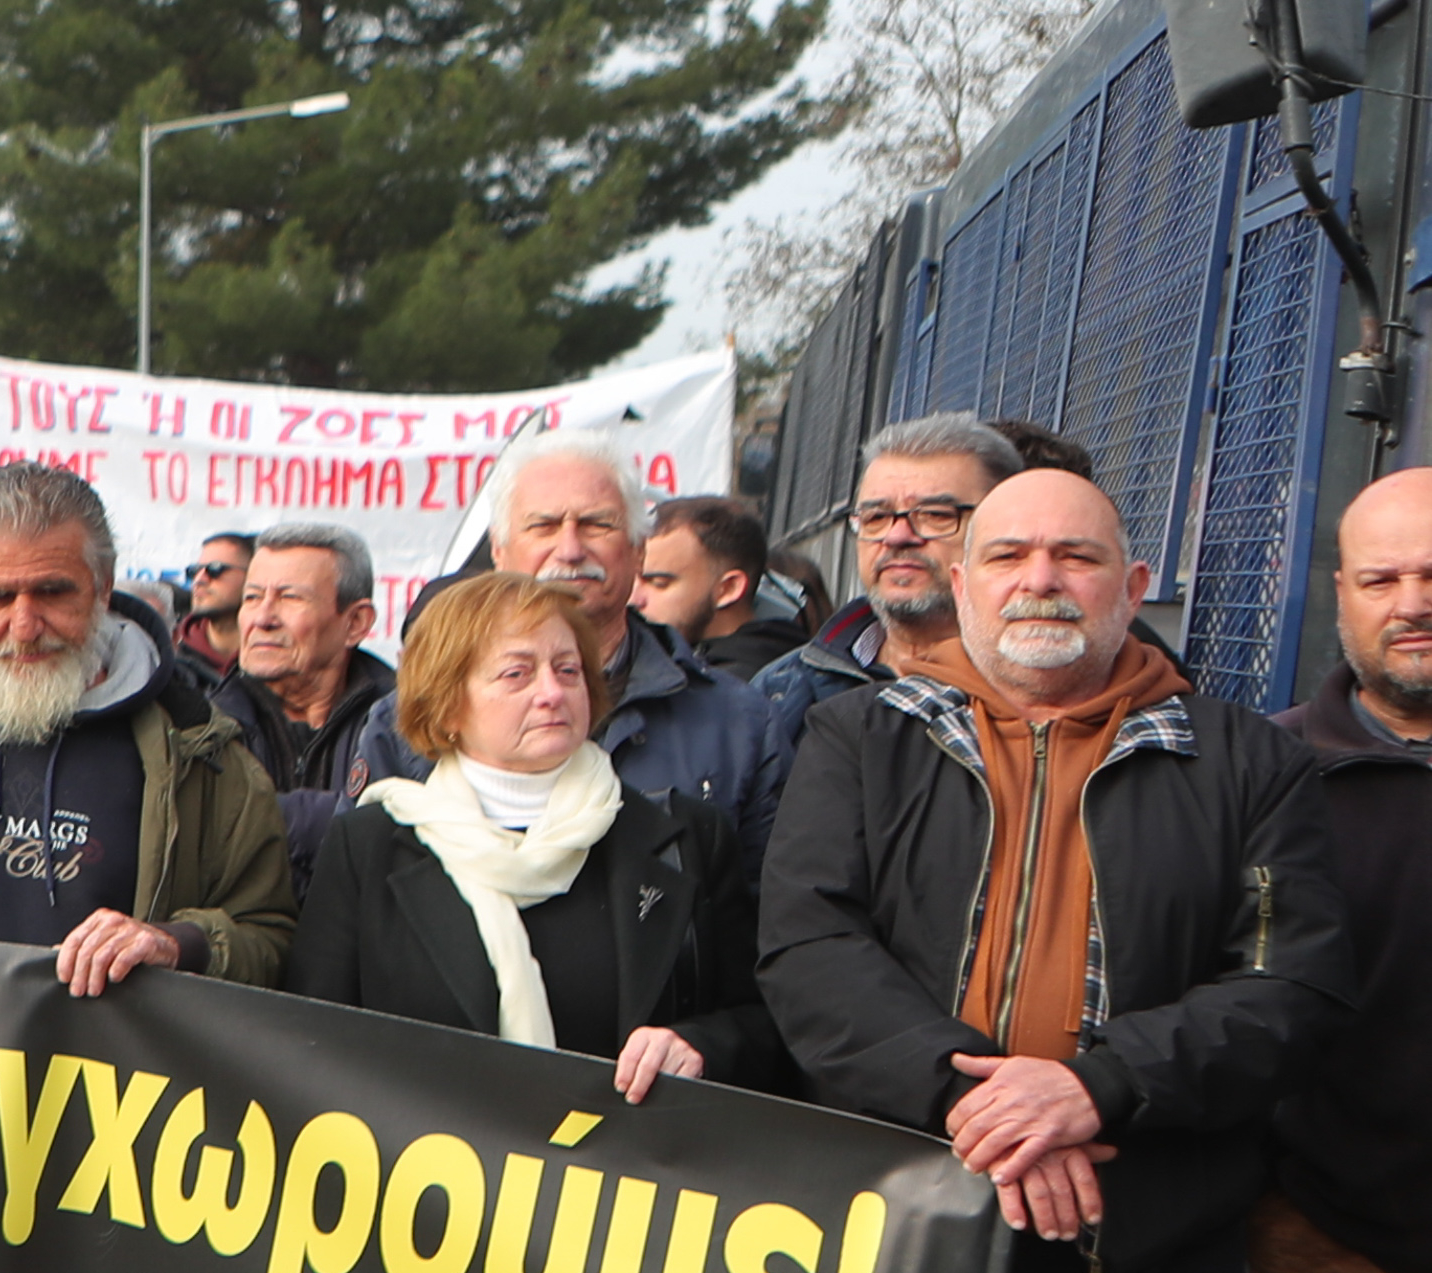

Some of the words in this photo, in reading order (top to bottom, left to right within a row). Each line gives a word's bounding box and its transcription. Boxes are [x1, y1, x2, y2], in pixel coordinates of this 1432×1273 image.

[0, 370, 118, 433] ΤΟΥΣ
[208, 400, 252, 441] ΟΙ
[143, 450, 190, 505] ΤΟ
[207, 451, 405, 509] ΕΓΚΛΗΜΑ
